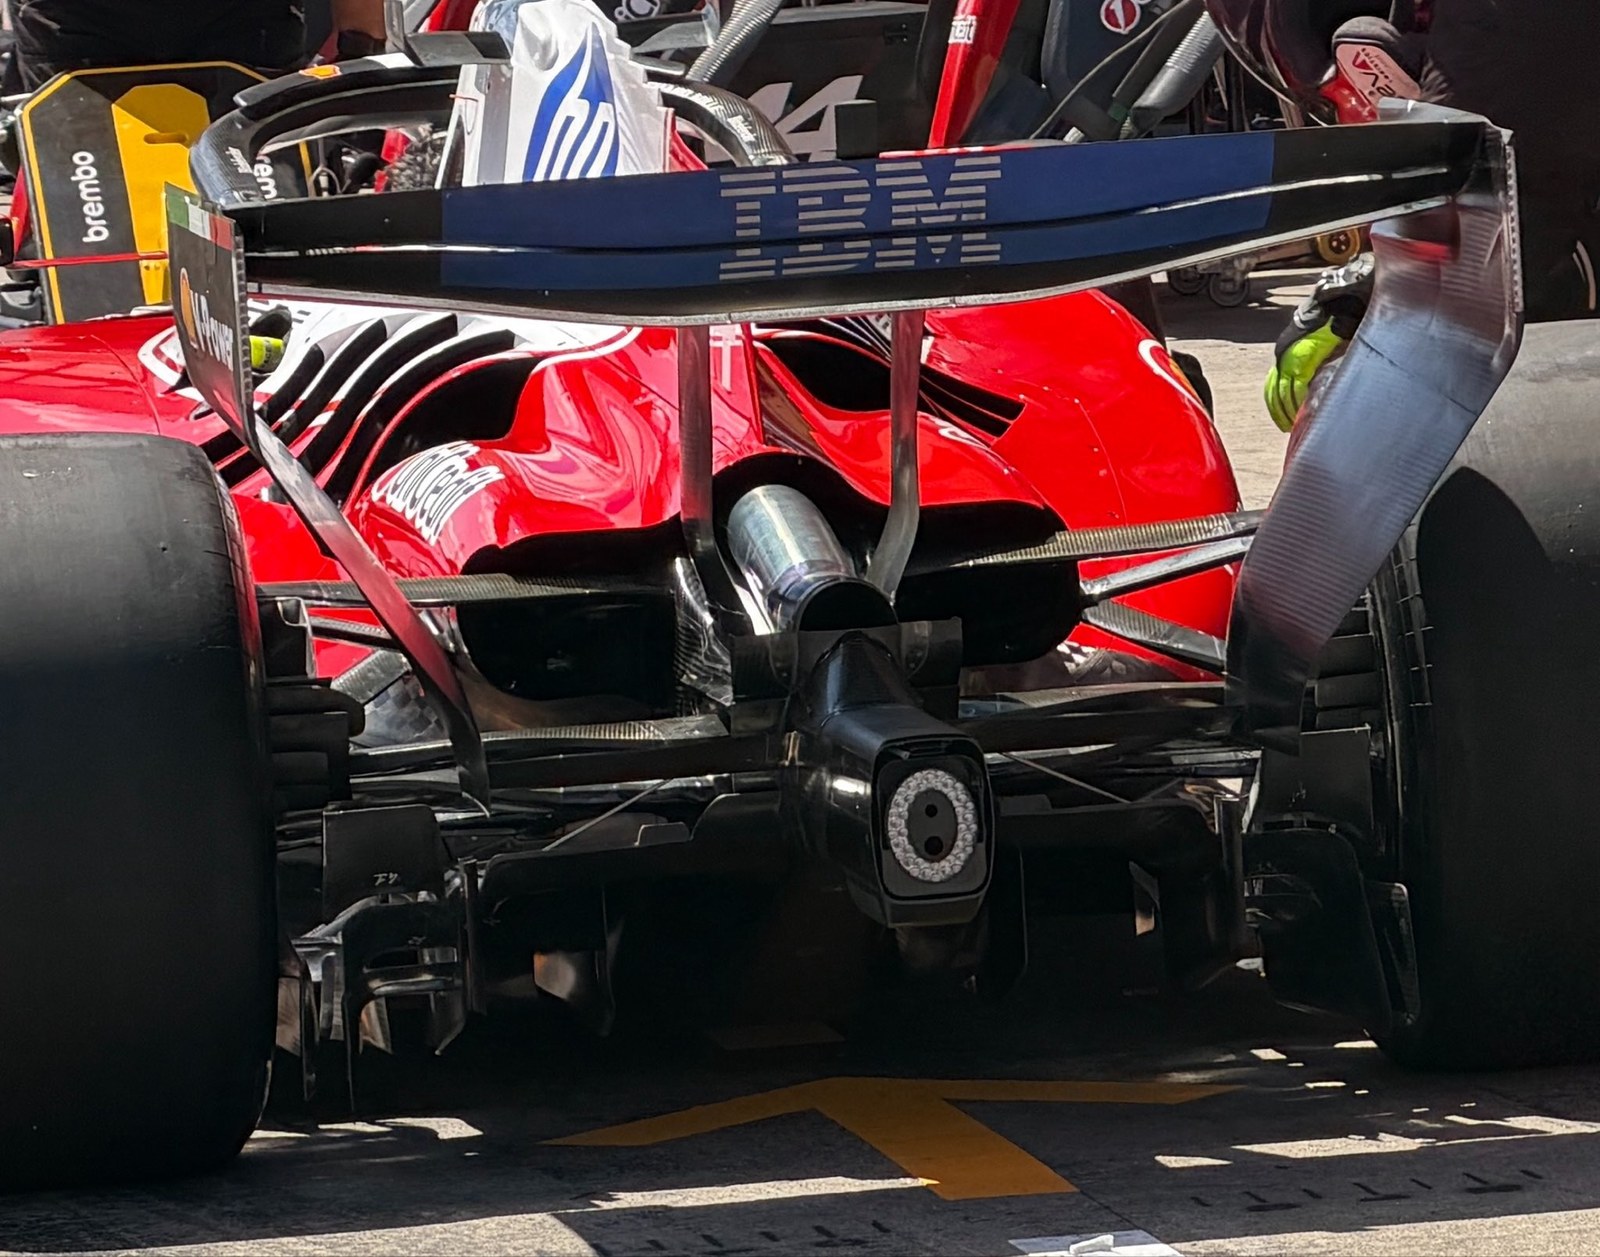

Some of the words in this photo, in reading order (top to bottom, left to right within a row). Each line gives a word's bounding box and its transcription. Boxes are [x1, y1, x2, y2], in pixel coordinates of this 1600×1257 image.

[70, 150, 110, 243] brembo
[253, 155, 279, 199] rem
[719, 155, 1001, 281] IBM
